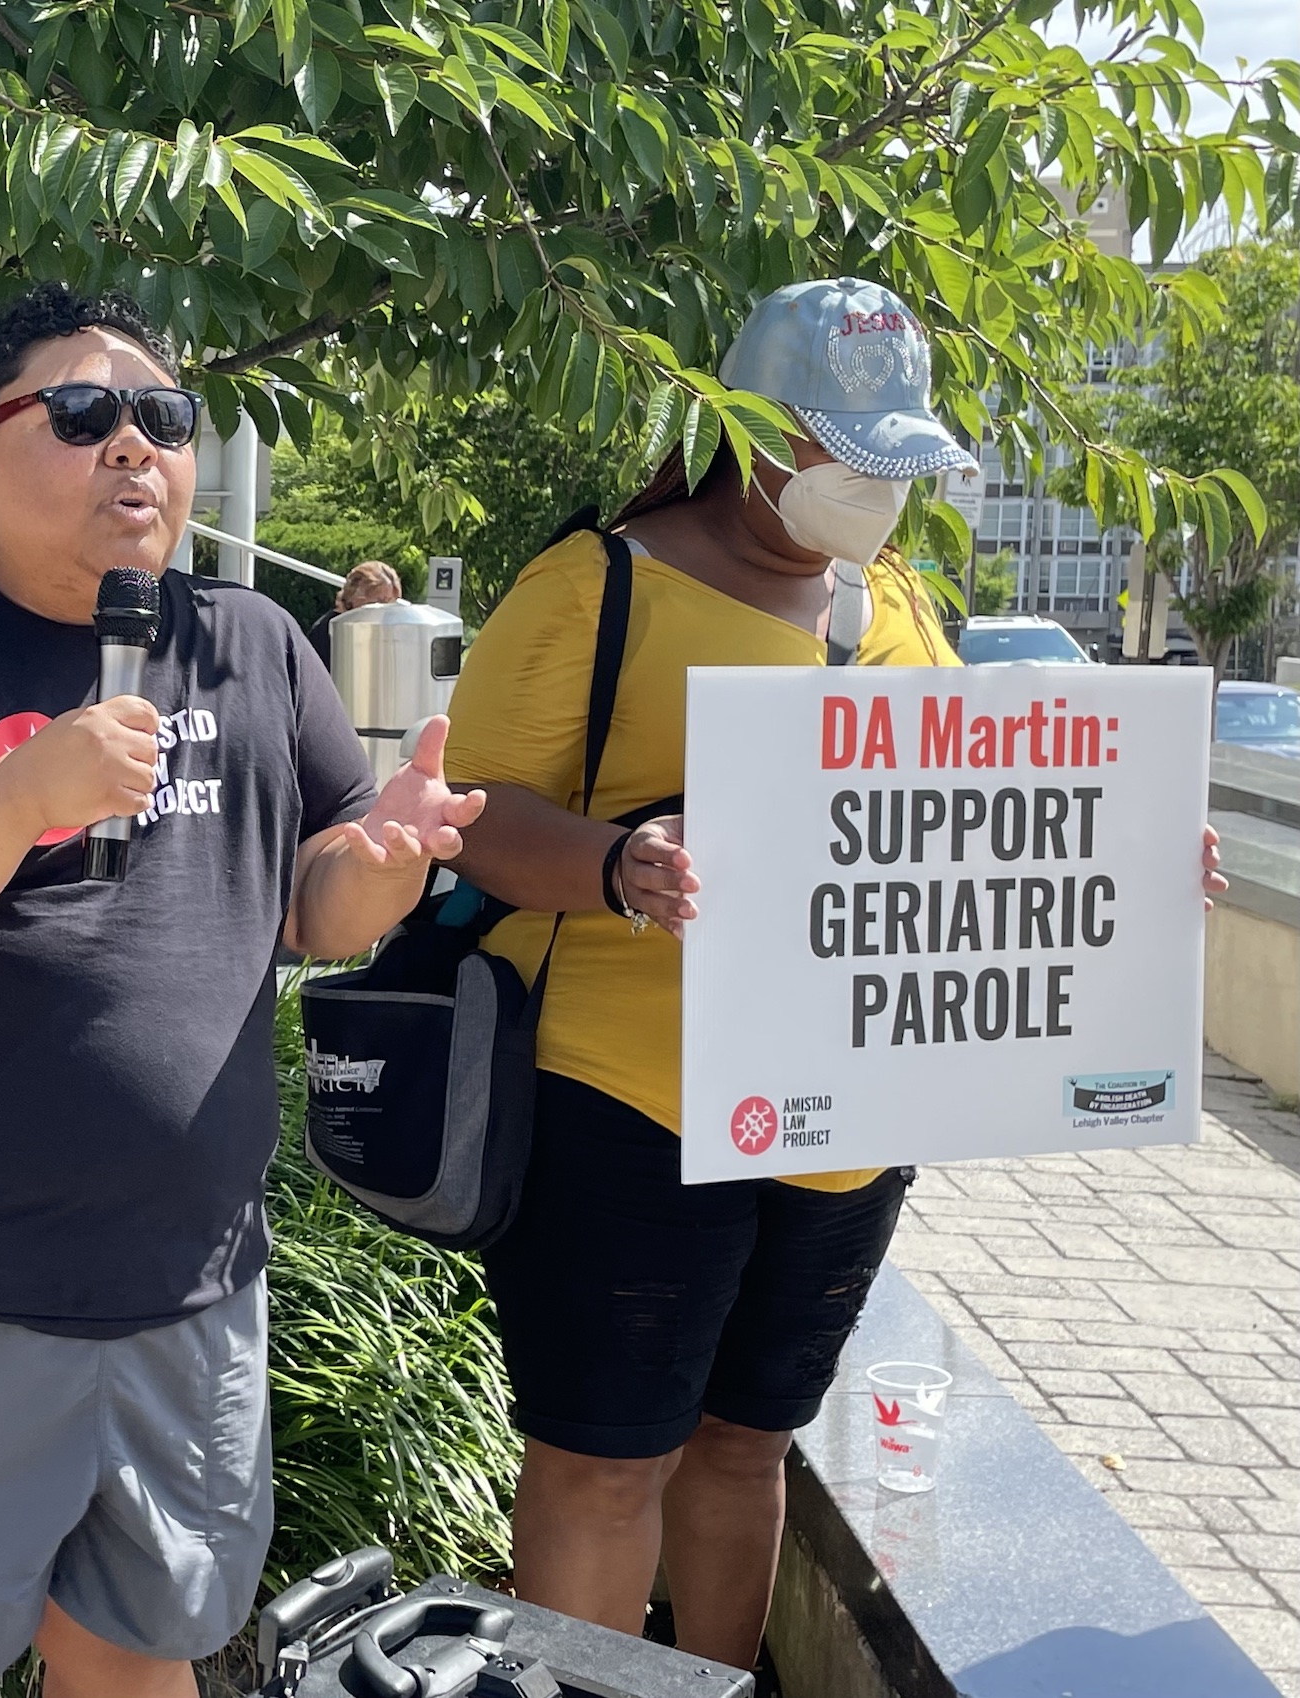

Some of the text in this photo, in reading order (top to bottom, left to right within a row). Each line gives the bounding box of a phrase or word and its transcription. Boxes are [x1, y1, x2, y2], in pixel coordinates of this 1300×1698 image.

[821, 696, 1119, 770] DA Martin:
[829, 787, 1103, 866] SUPPORT
[809, 874, 1116, 959] GERIATRIC
[852, 965, 1074, 1048] PAROLE
[783, 1096, 832, 1113] AMISTAD
[1088, 1098, 1153, 1110] BY INCARCERATION
[1094, 1090, 1148, 1103] ABOLISH DEATH
[783, 1115, 806, 1131] LAW
[1072, 1114, 1164, 1128] Lehigh Valley Chapter
[783, 1130, 831, 1148] PROJECT
